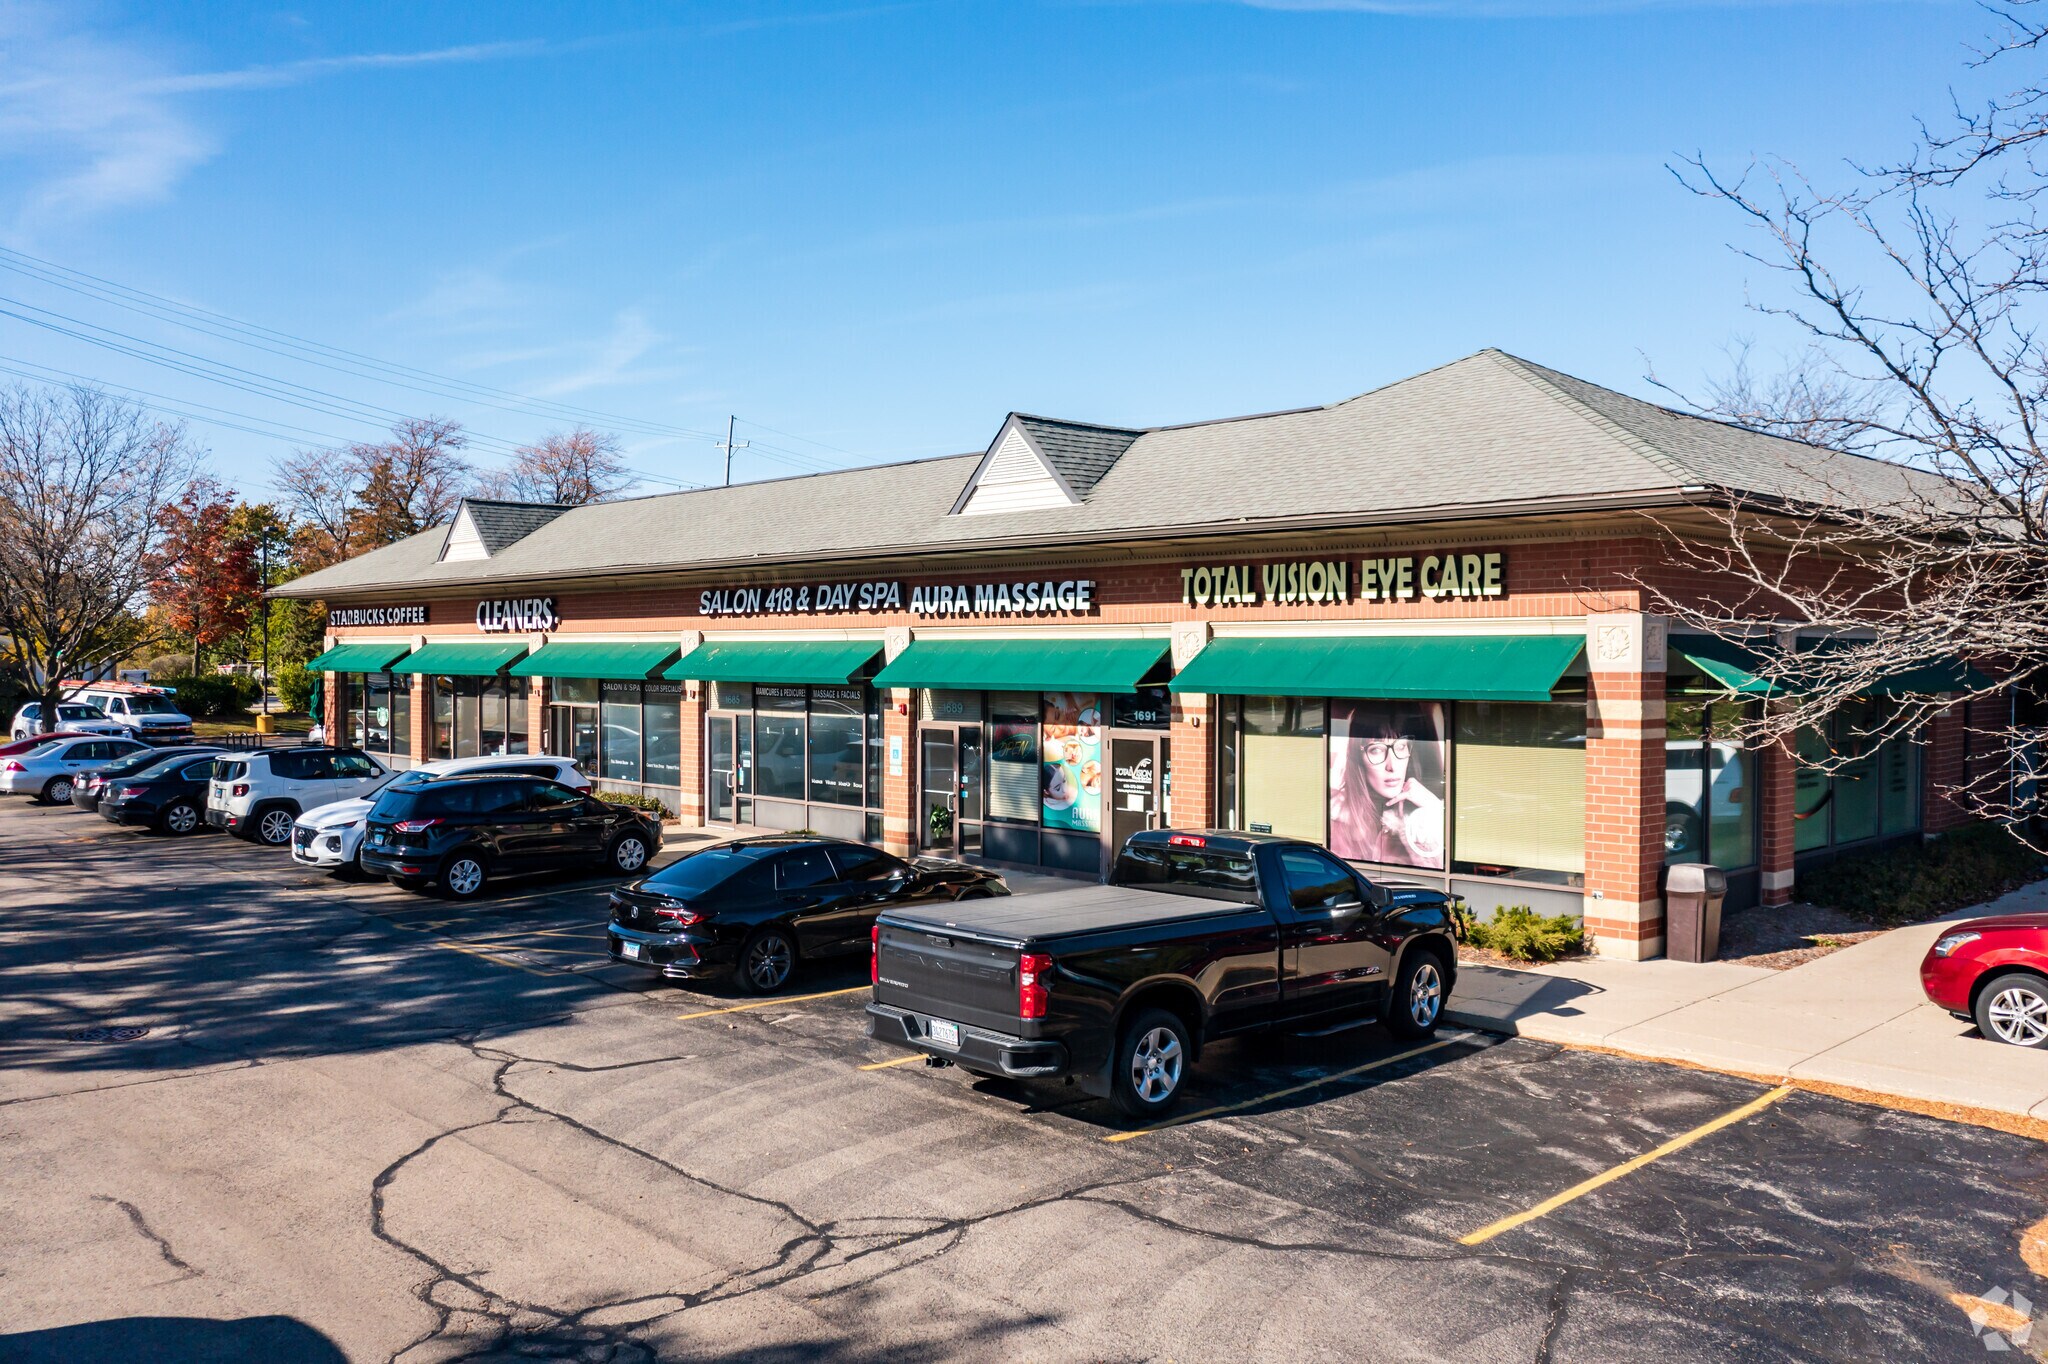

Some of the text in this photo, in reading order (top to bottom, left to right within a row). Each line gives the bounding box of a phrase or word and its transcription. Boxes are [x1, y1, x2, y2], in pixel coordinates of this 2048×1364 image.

[1181, 553, 1501, 605] TOTAL VISION EYE CARE
[699, 581, 900, 615] SALON 418 & DAY SPA
[909, 580, 1091, 614] AURA MASSAGE
[330, 606, 425, 626] STARBUCKS COFFEE
[476, 597, 553, 631] CLEANERS
[602, 683, 622, 691] SALON
[629, 684, 641, 692] SPA
[645, 684, 682, 693] COLOR SPECIALIS
[756, 687, 779, 697] MANICURES
[725, 695, 740, 705] 1685
[813, 689, 835, 699] MASSAGE
[841, 691, 860, 700] FACIALS
[943, 703, 963, 714] 1689
[1134, 711, 1156, 721] 1691
[1000, 740, 1030, 757] OPEN
[879, 976, 909, 989] SILVERADO
